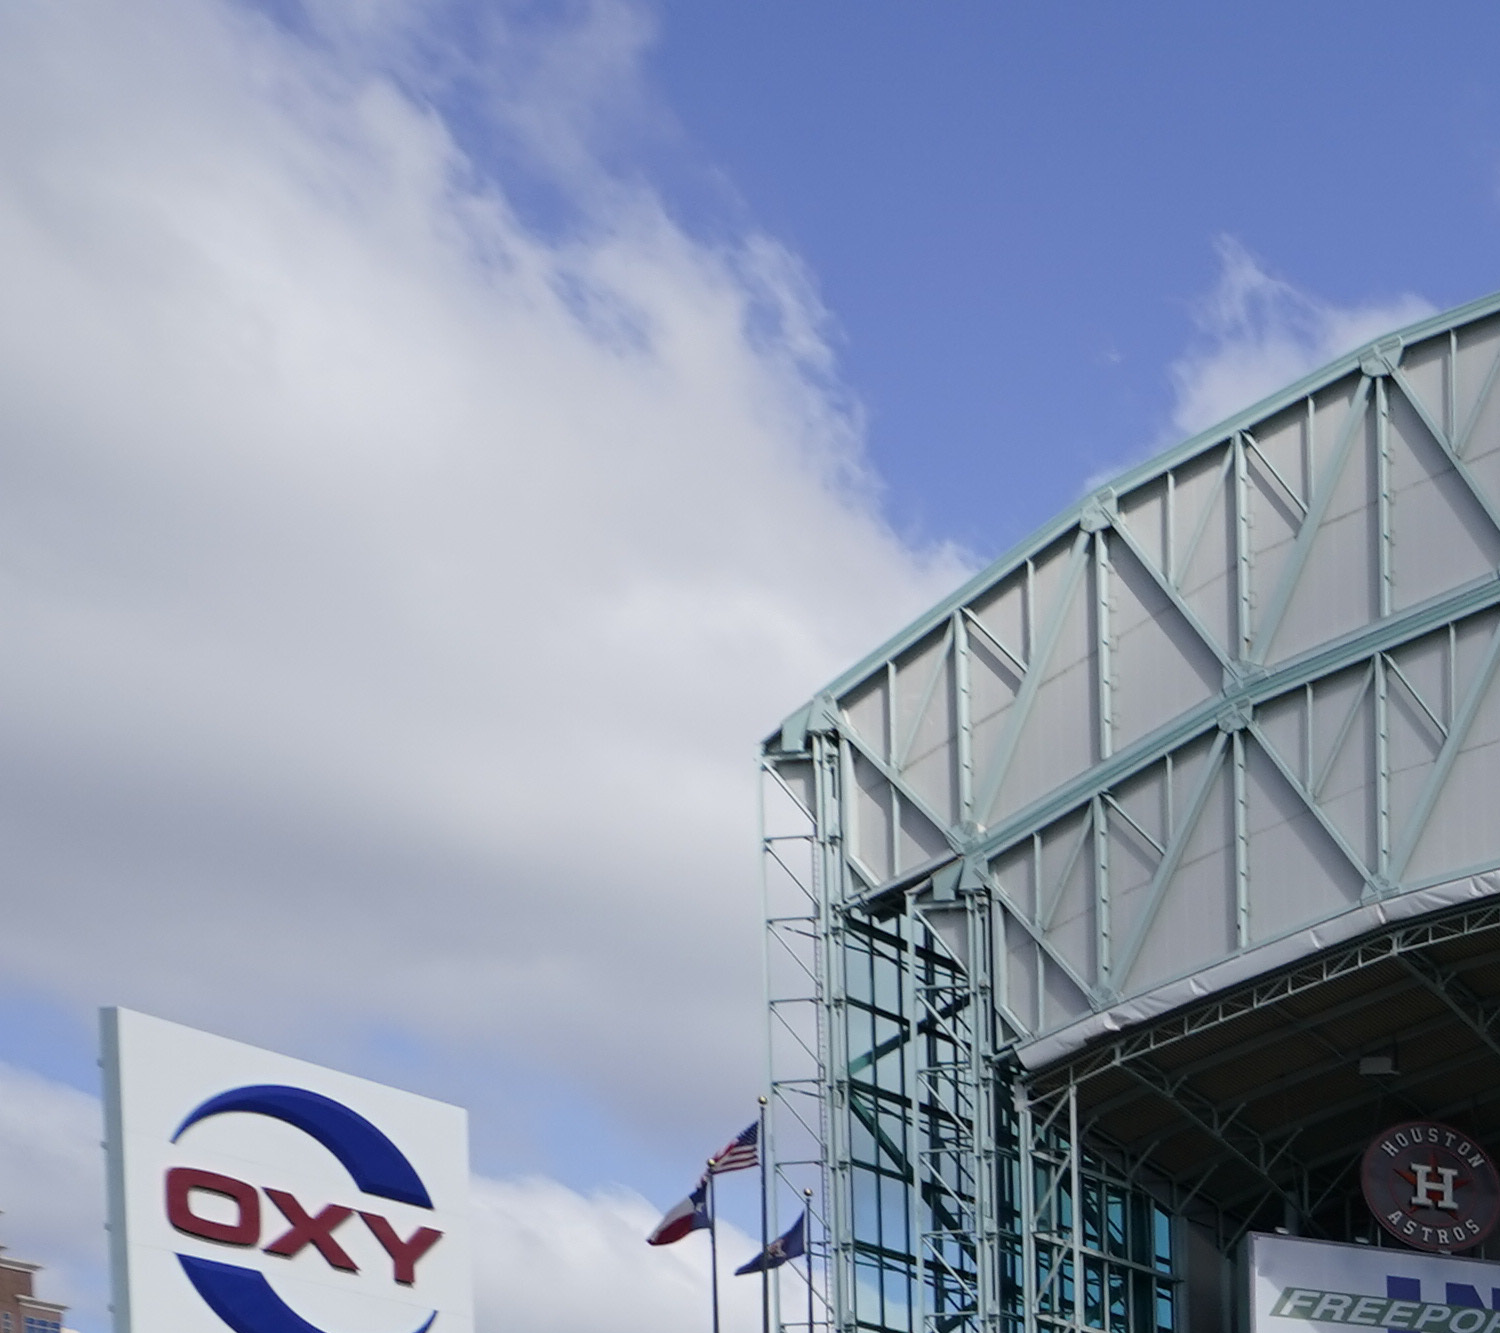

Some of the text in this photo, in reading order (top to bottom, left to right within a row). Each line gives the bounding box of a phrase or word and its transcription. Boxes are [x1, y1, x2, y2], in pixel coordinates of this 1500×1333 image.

[1381, 1127, 1486, 1168] HOUSTON
[165, 1166, 445, 1288] OXY
[1387, 1210, 1481, 1245] ASTROS
